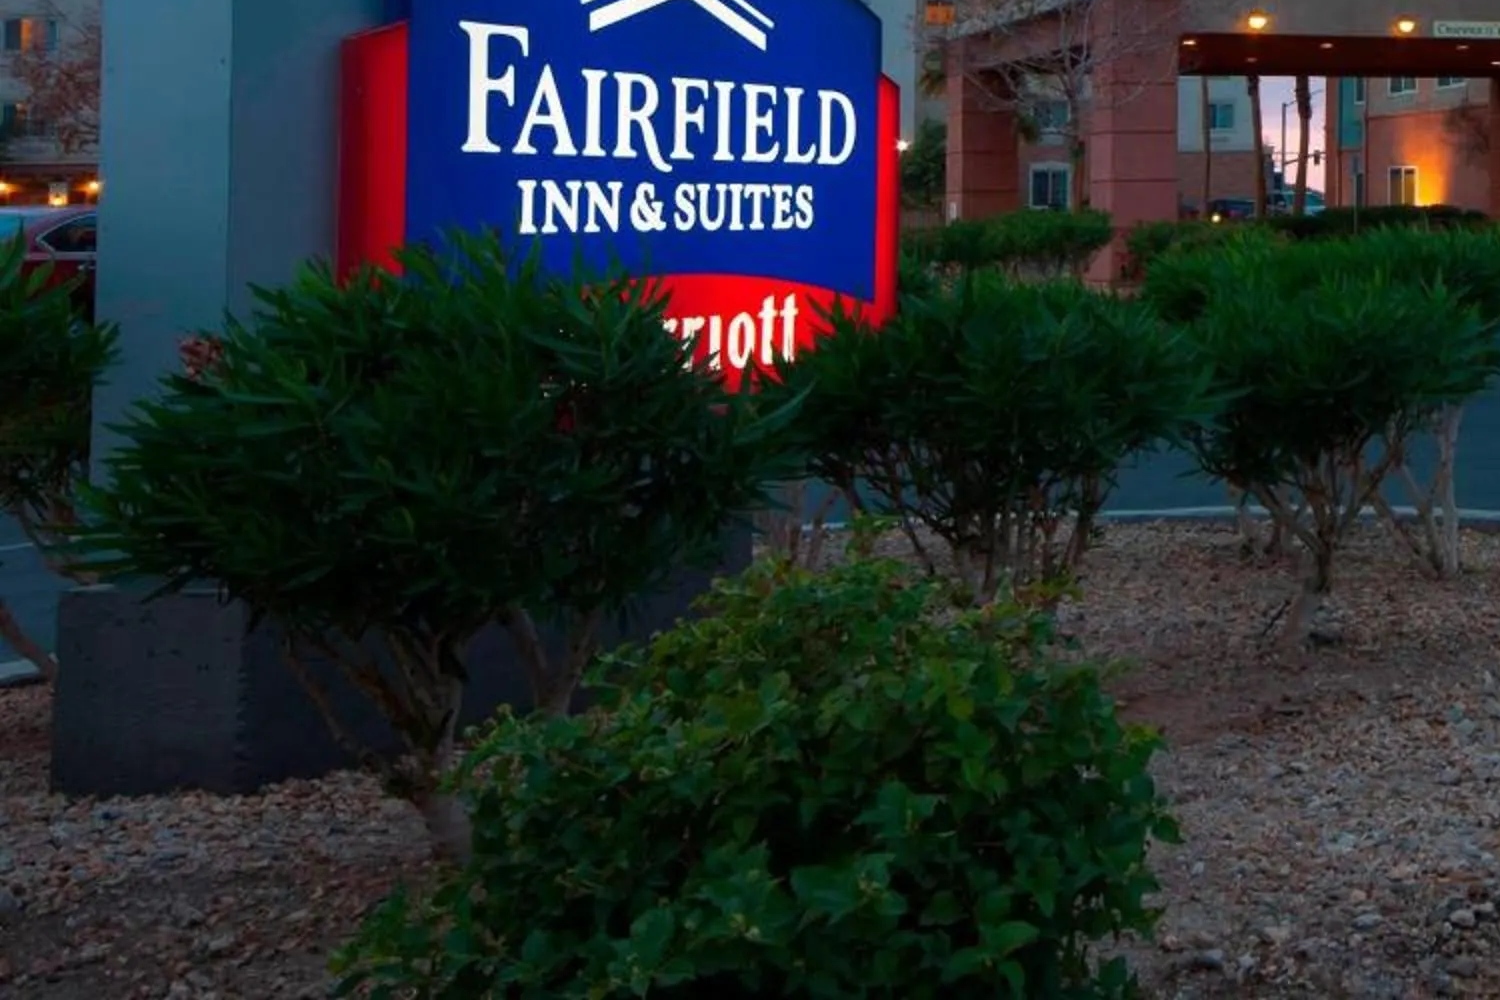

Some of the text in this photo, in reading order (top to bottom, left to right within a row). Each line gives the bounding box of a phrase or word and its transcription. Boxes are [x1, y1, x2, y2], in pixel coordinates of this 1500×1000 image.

[459, 20, 857, 172] FAIRFIELD
[518, 179, 815, 235] INN & SUITES
[662, 292, 798, 372] riott
